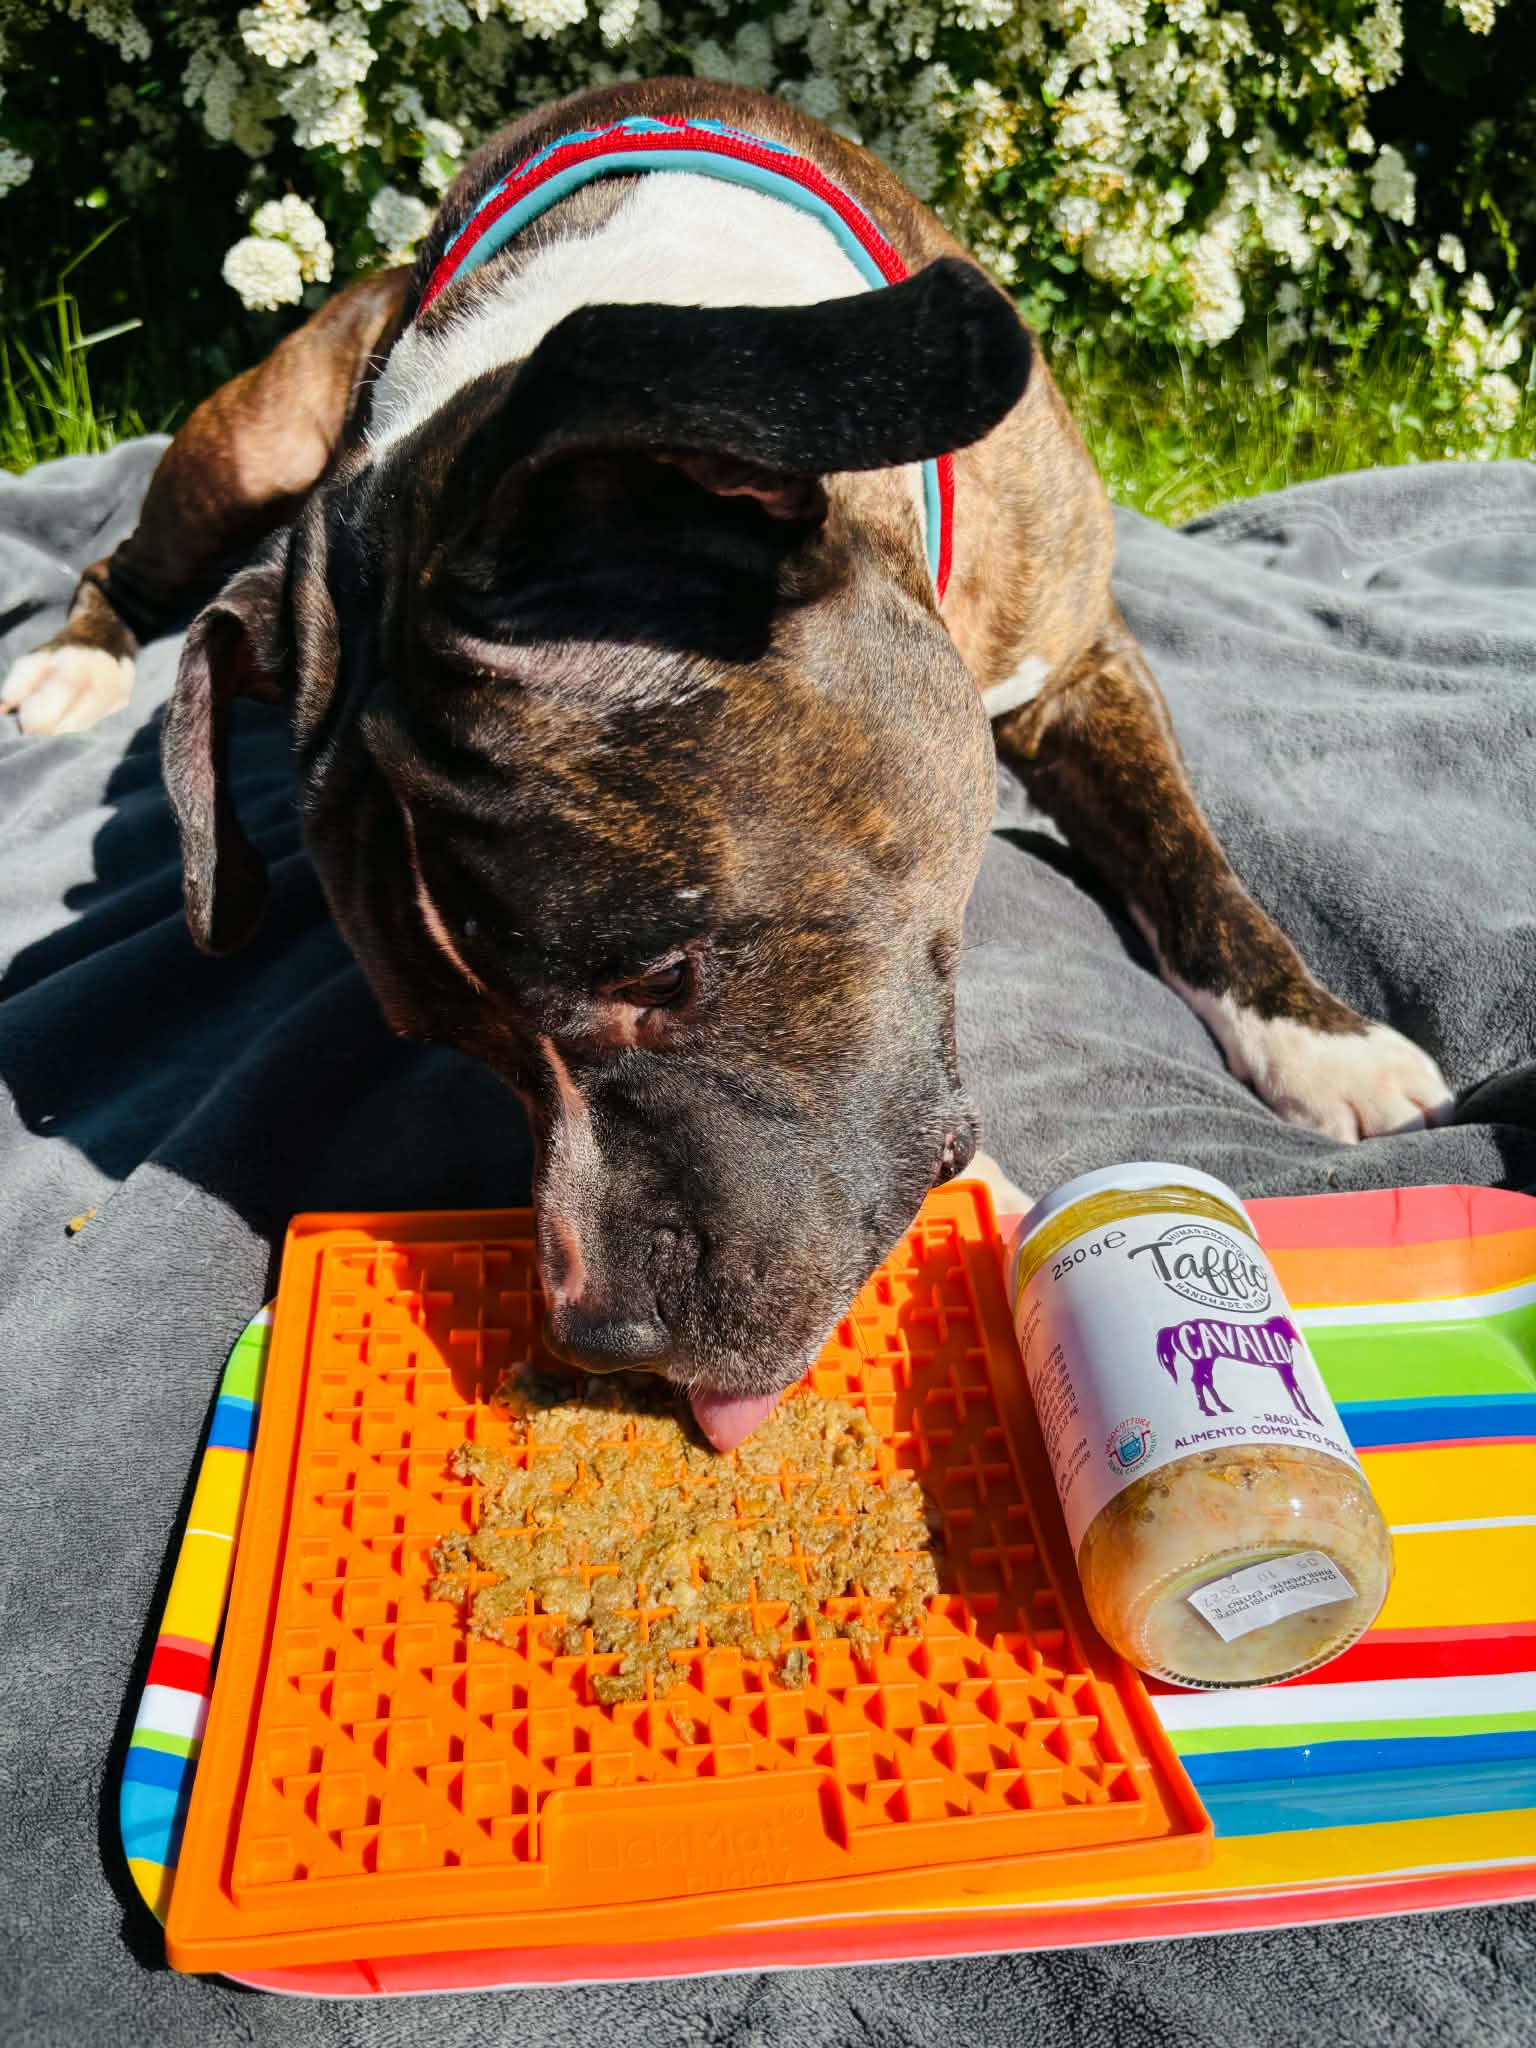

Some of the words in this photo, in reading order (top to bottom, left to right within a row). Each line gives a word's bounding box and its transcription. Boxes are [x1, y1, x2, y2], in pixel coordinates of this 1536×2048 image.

[1166, 1228, 1201, 1241] HUMAN
[1176, 1282, 1243, 1309] HANDMADE
[1178, 1322, 1292, 1364] CAVALLO
[1174, 1426, 1247, 1450] ALIMENTO
[1251, 1424, 1322, 1444] COMPLETO
